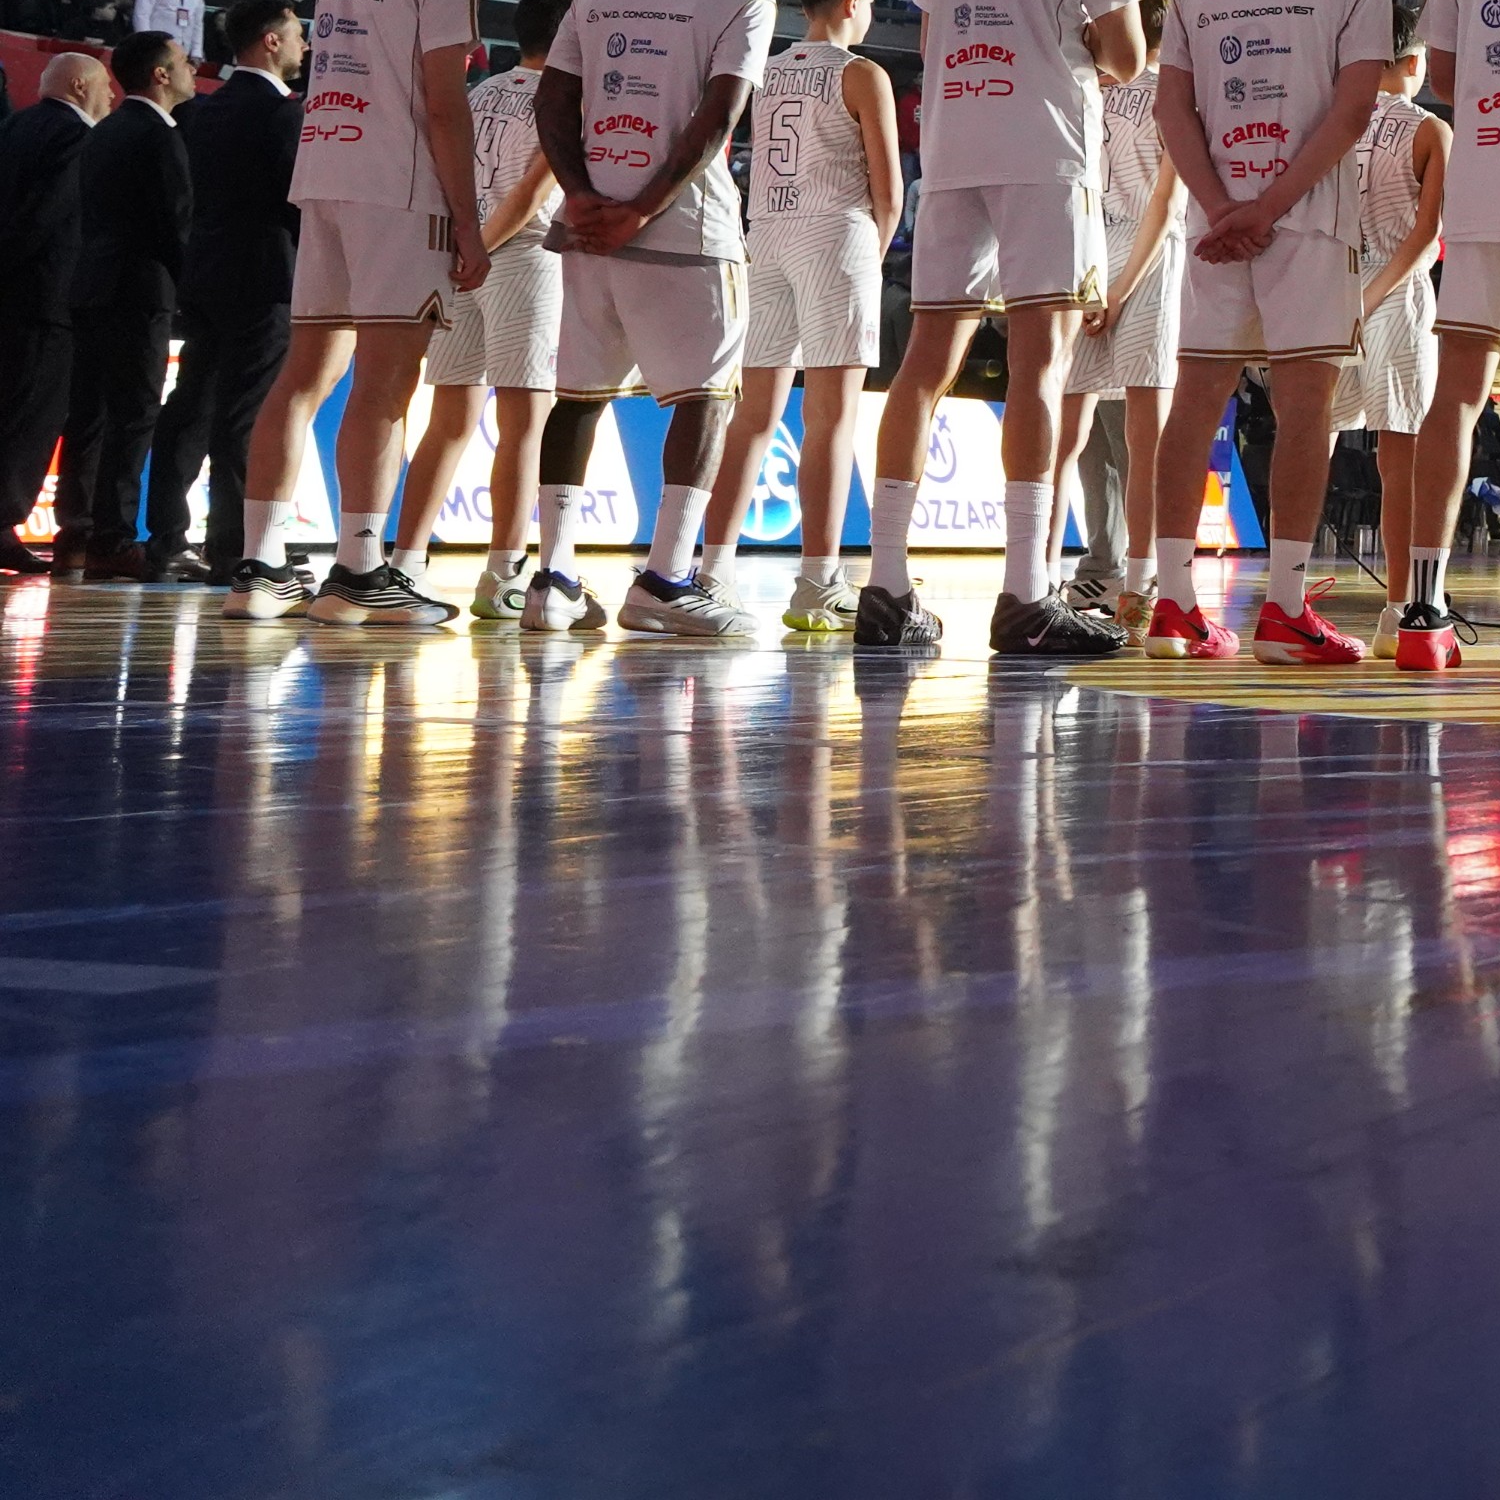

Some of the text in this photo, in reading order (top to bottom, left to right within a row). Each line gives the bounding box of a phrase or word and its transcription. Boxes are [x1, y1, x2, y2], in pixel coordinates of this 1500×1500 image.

[623, 11, 666, 21] CONCORD
[669, 13, 694, 23] WEST
[1232, 7, 1283, 18] CONCORD
[1285, 6, 1314, 16] WEST
[946, 44, 1016, 69] carnex
[306, 91, 370, 113] carnex
[593, 114, 659, 138] carnex
[769, 101, 802, 176] 5
[475, 117, 507, 188] 4
[768, 180, 800, 213] NIŠ
[909, 501, 1006, 529] OZZAR
